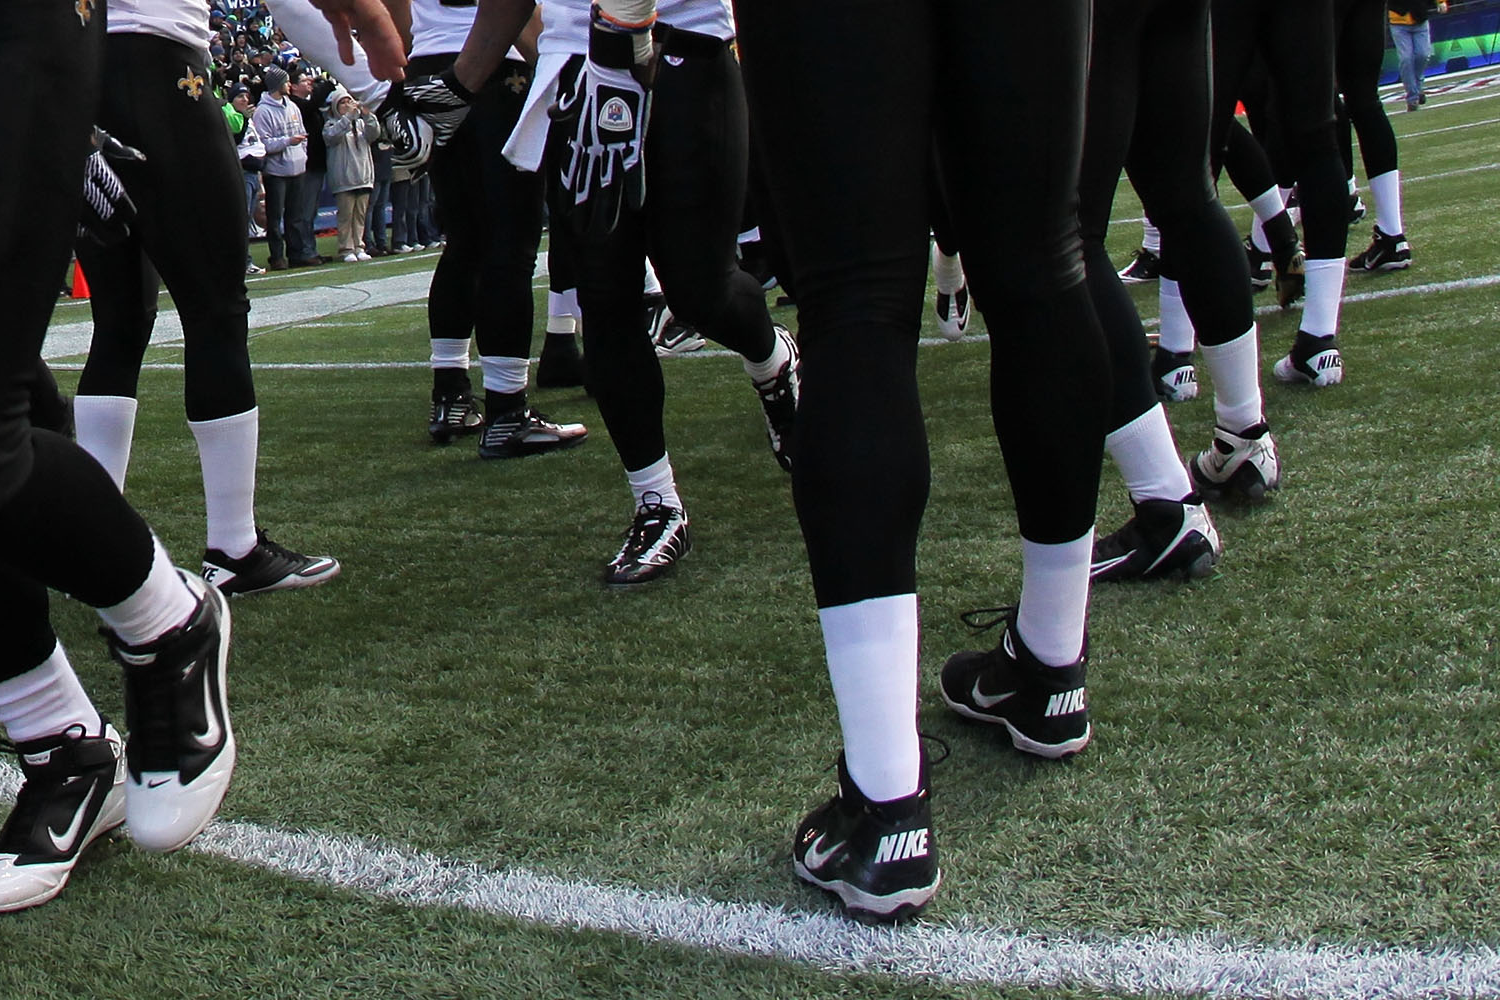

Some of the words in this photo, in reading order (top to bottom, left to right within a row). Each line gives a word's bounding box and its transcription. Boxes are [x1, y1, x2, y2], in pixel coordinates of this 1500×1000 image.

[1317, 354, 1341, 371] NIKE
[1046, 687, 1086, 717] NIKE
[875, 828, 928, 864] NIKE
